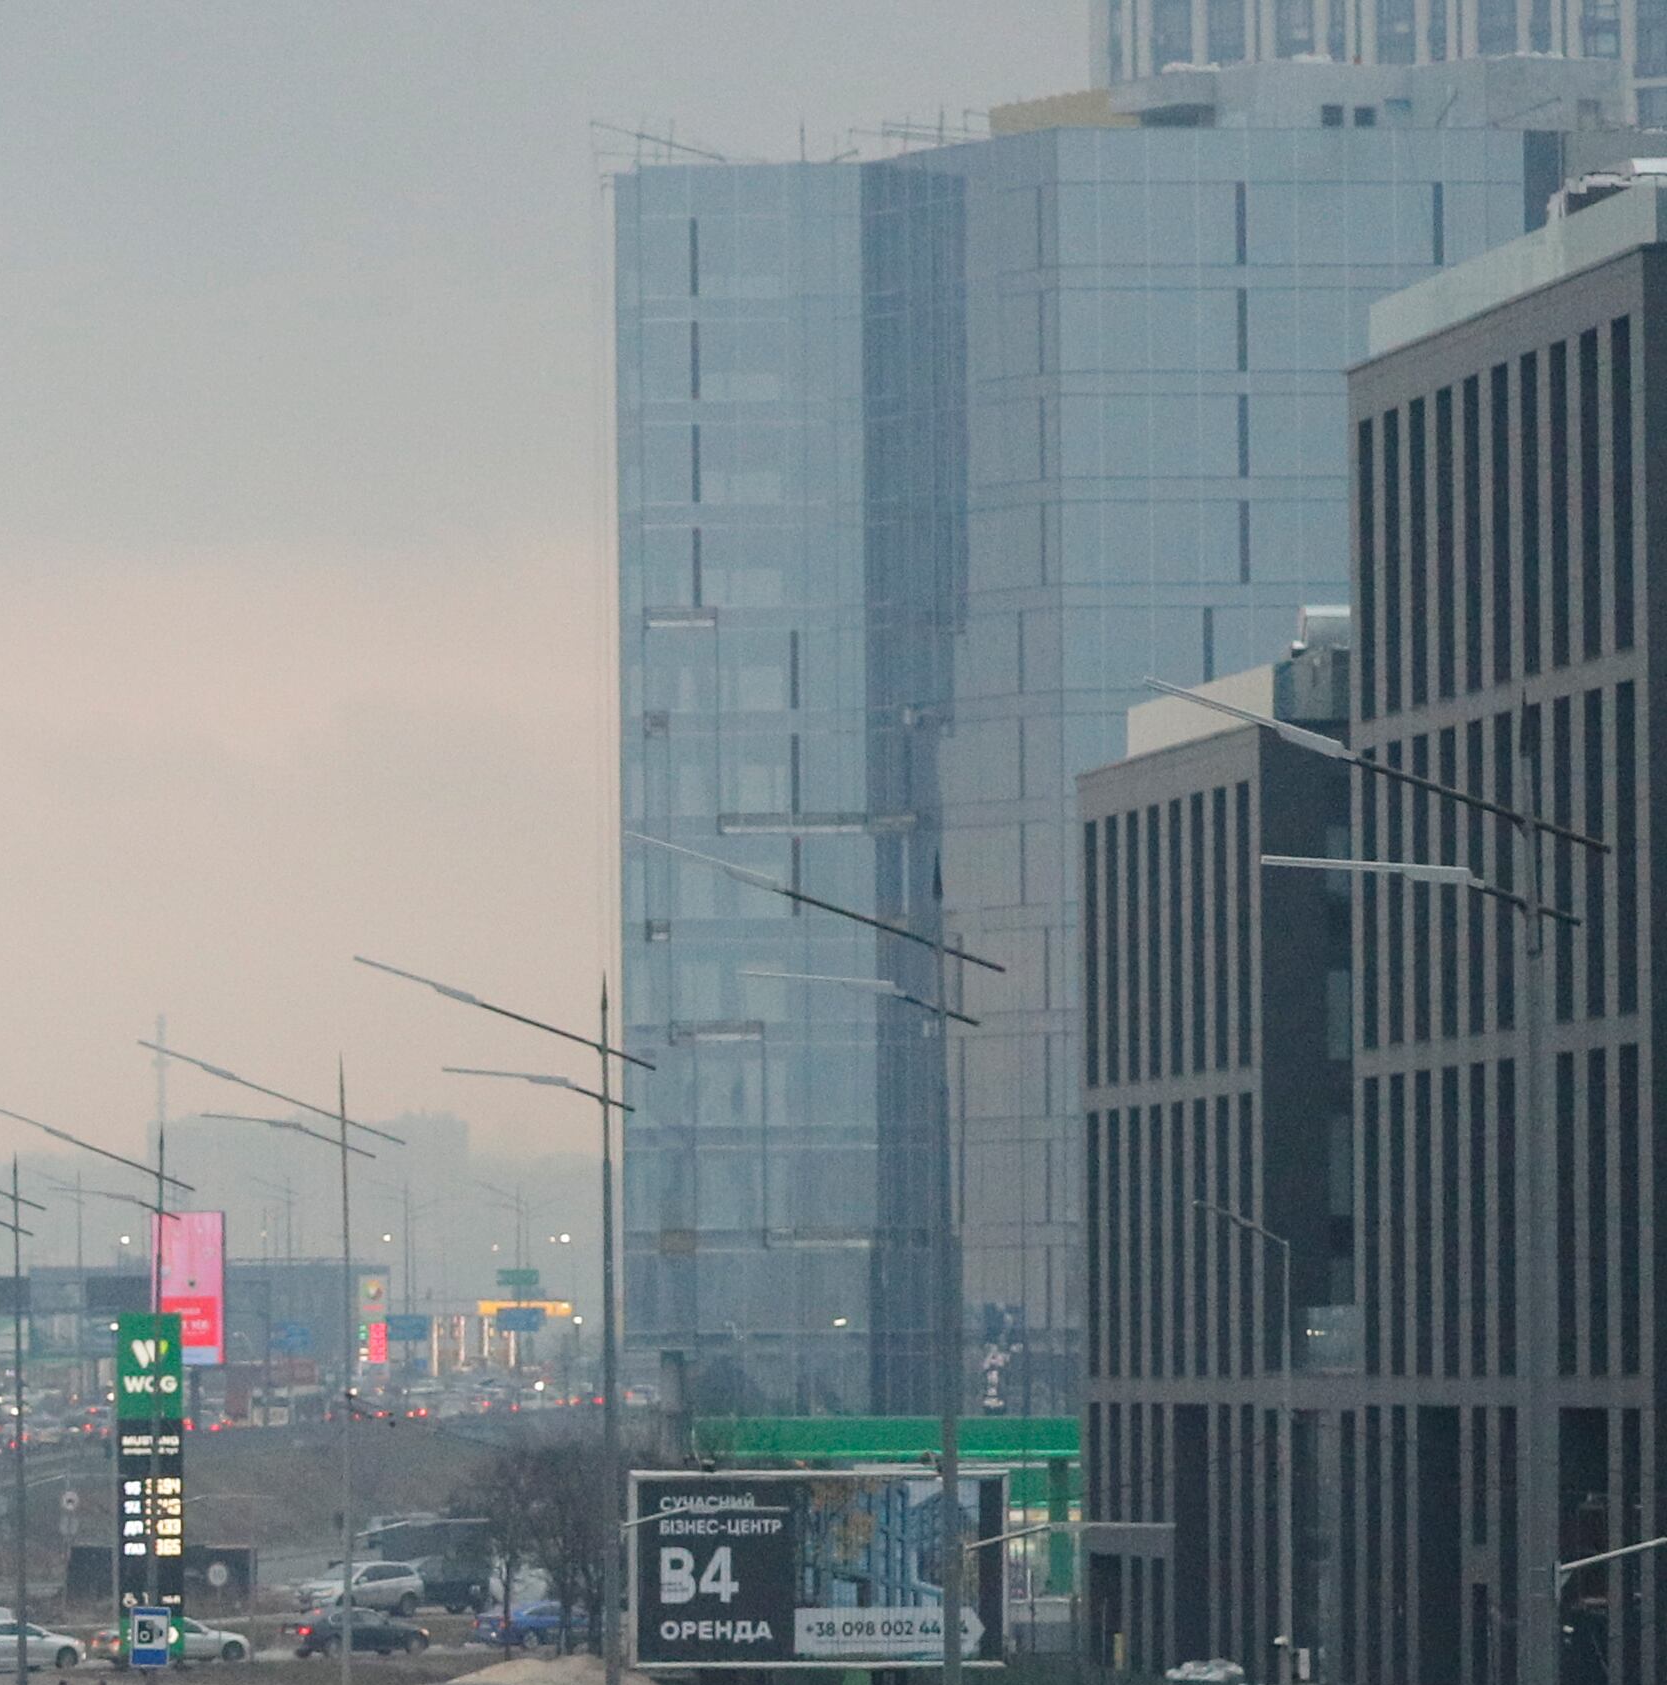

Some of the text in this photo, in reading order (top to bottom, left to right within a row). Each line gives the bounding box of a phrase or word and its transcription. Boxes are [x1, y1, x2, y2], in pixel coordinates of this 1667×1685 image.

[659, 1491, 755, 1511] СУЧАСНИЙ
[659, 1518, 783, 1536] БІЗНЕС-ЦЕНТР
[659, 1546, 740, 1604] B4
[659, 1620, 773, 1643] ОРЕНДА
[806, 1621, 836, 1637] +38
[841, 1621, 876, 1636] 098
[880, 1620, 913, 1636] 002
[919, 1621, 941, 1635] 44
